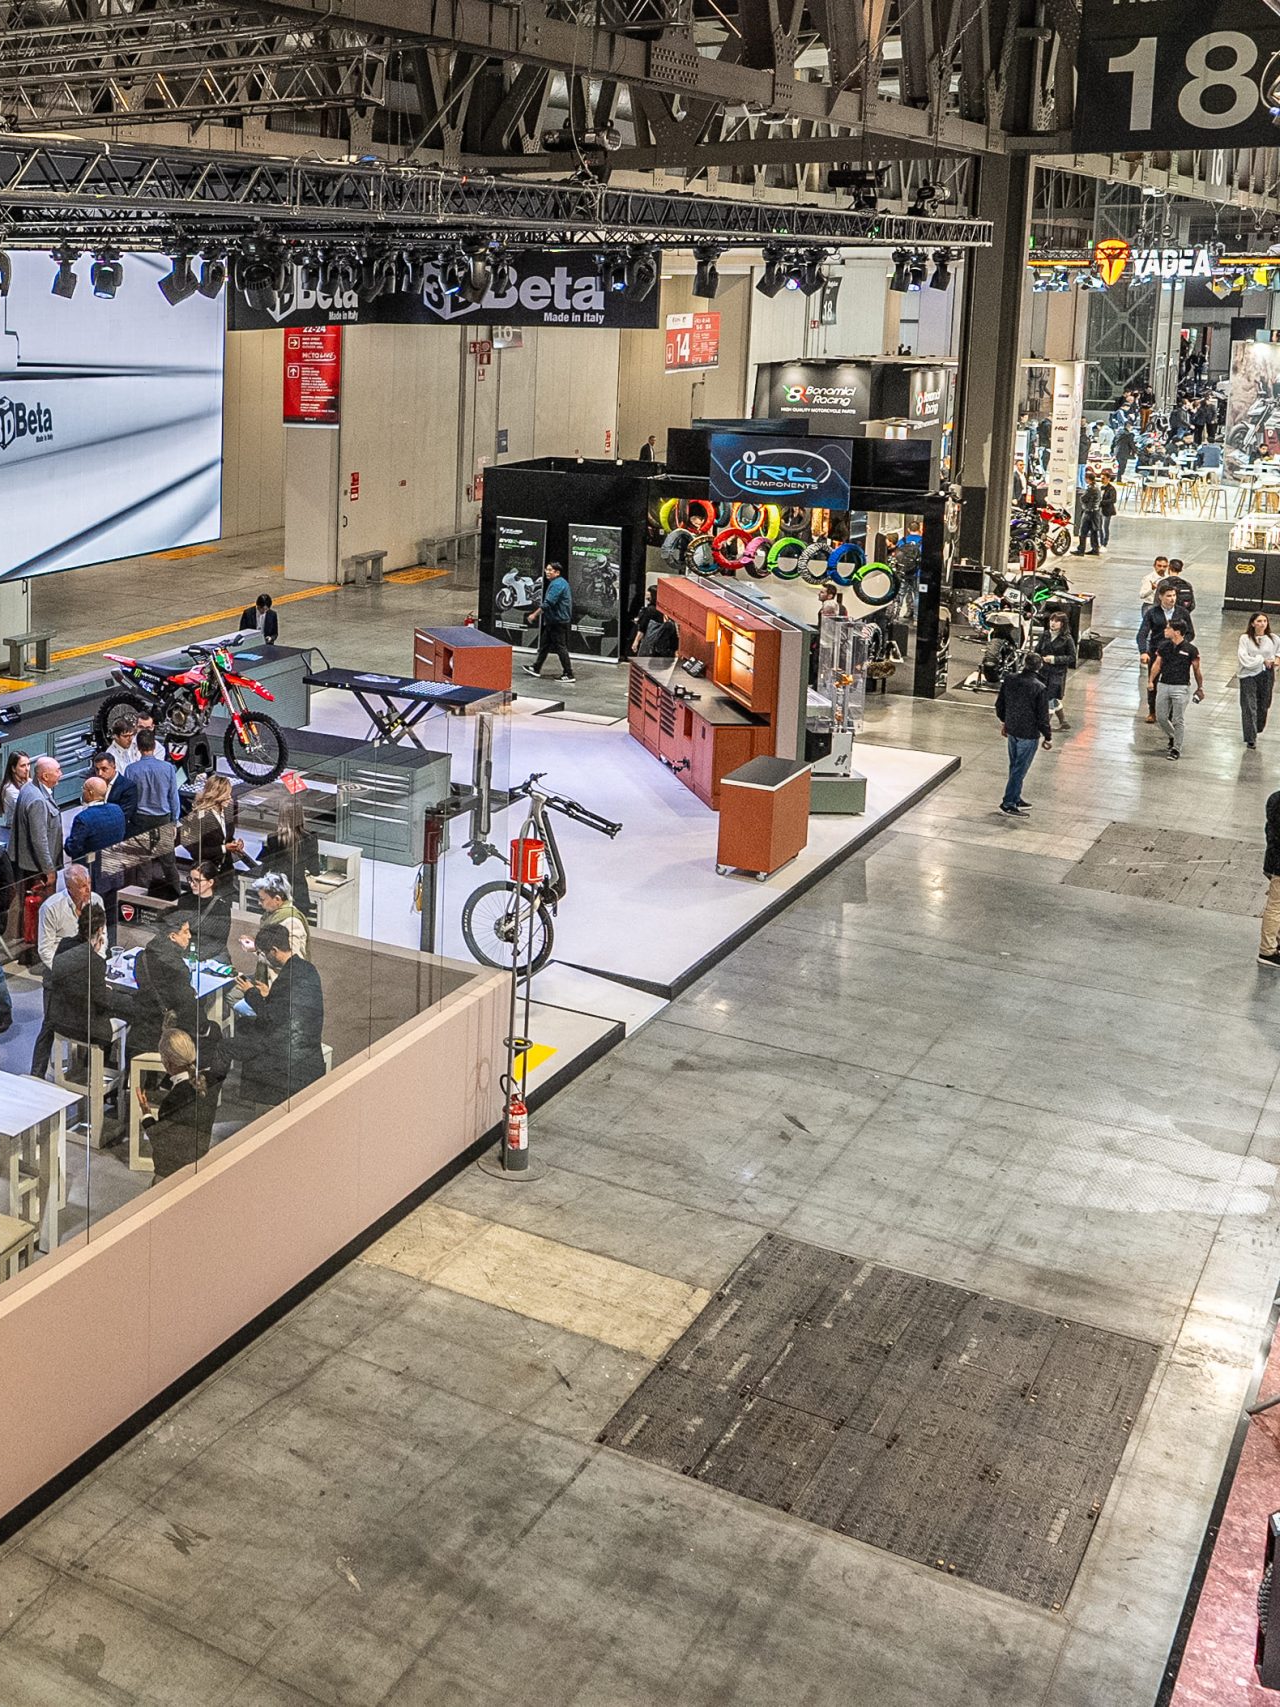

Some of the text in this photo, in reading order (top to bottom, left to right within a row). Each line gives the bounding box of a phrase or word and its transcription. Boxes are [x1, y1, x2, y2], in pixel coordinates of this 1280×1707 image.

[1108, 31, 1259, 131] 18
[1131, 249, 1211, 277] YADEA
[482, 265, 605, 311] Beta
[544, 312, 605, 324] Made in Italy
[824, 301, 832, 320] 18
[676, 333, 690, 362] 14
[813, 395, 851, 406] Racing
[15, 402, 53, 438] Beta
[745, 480, 818, 490] COMPONENTS
